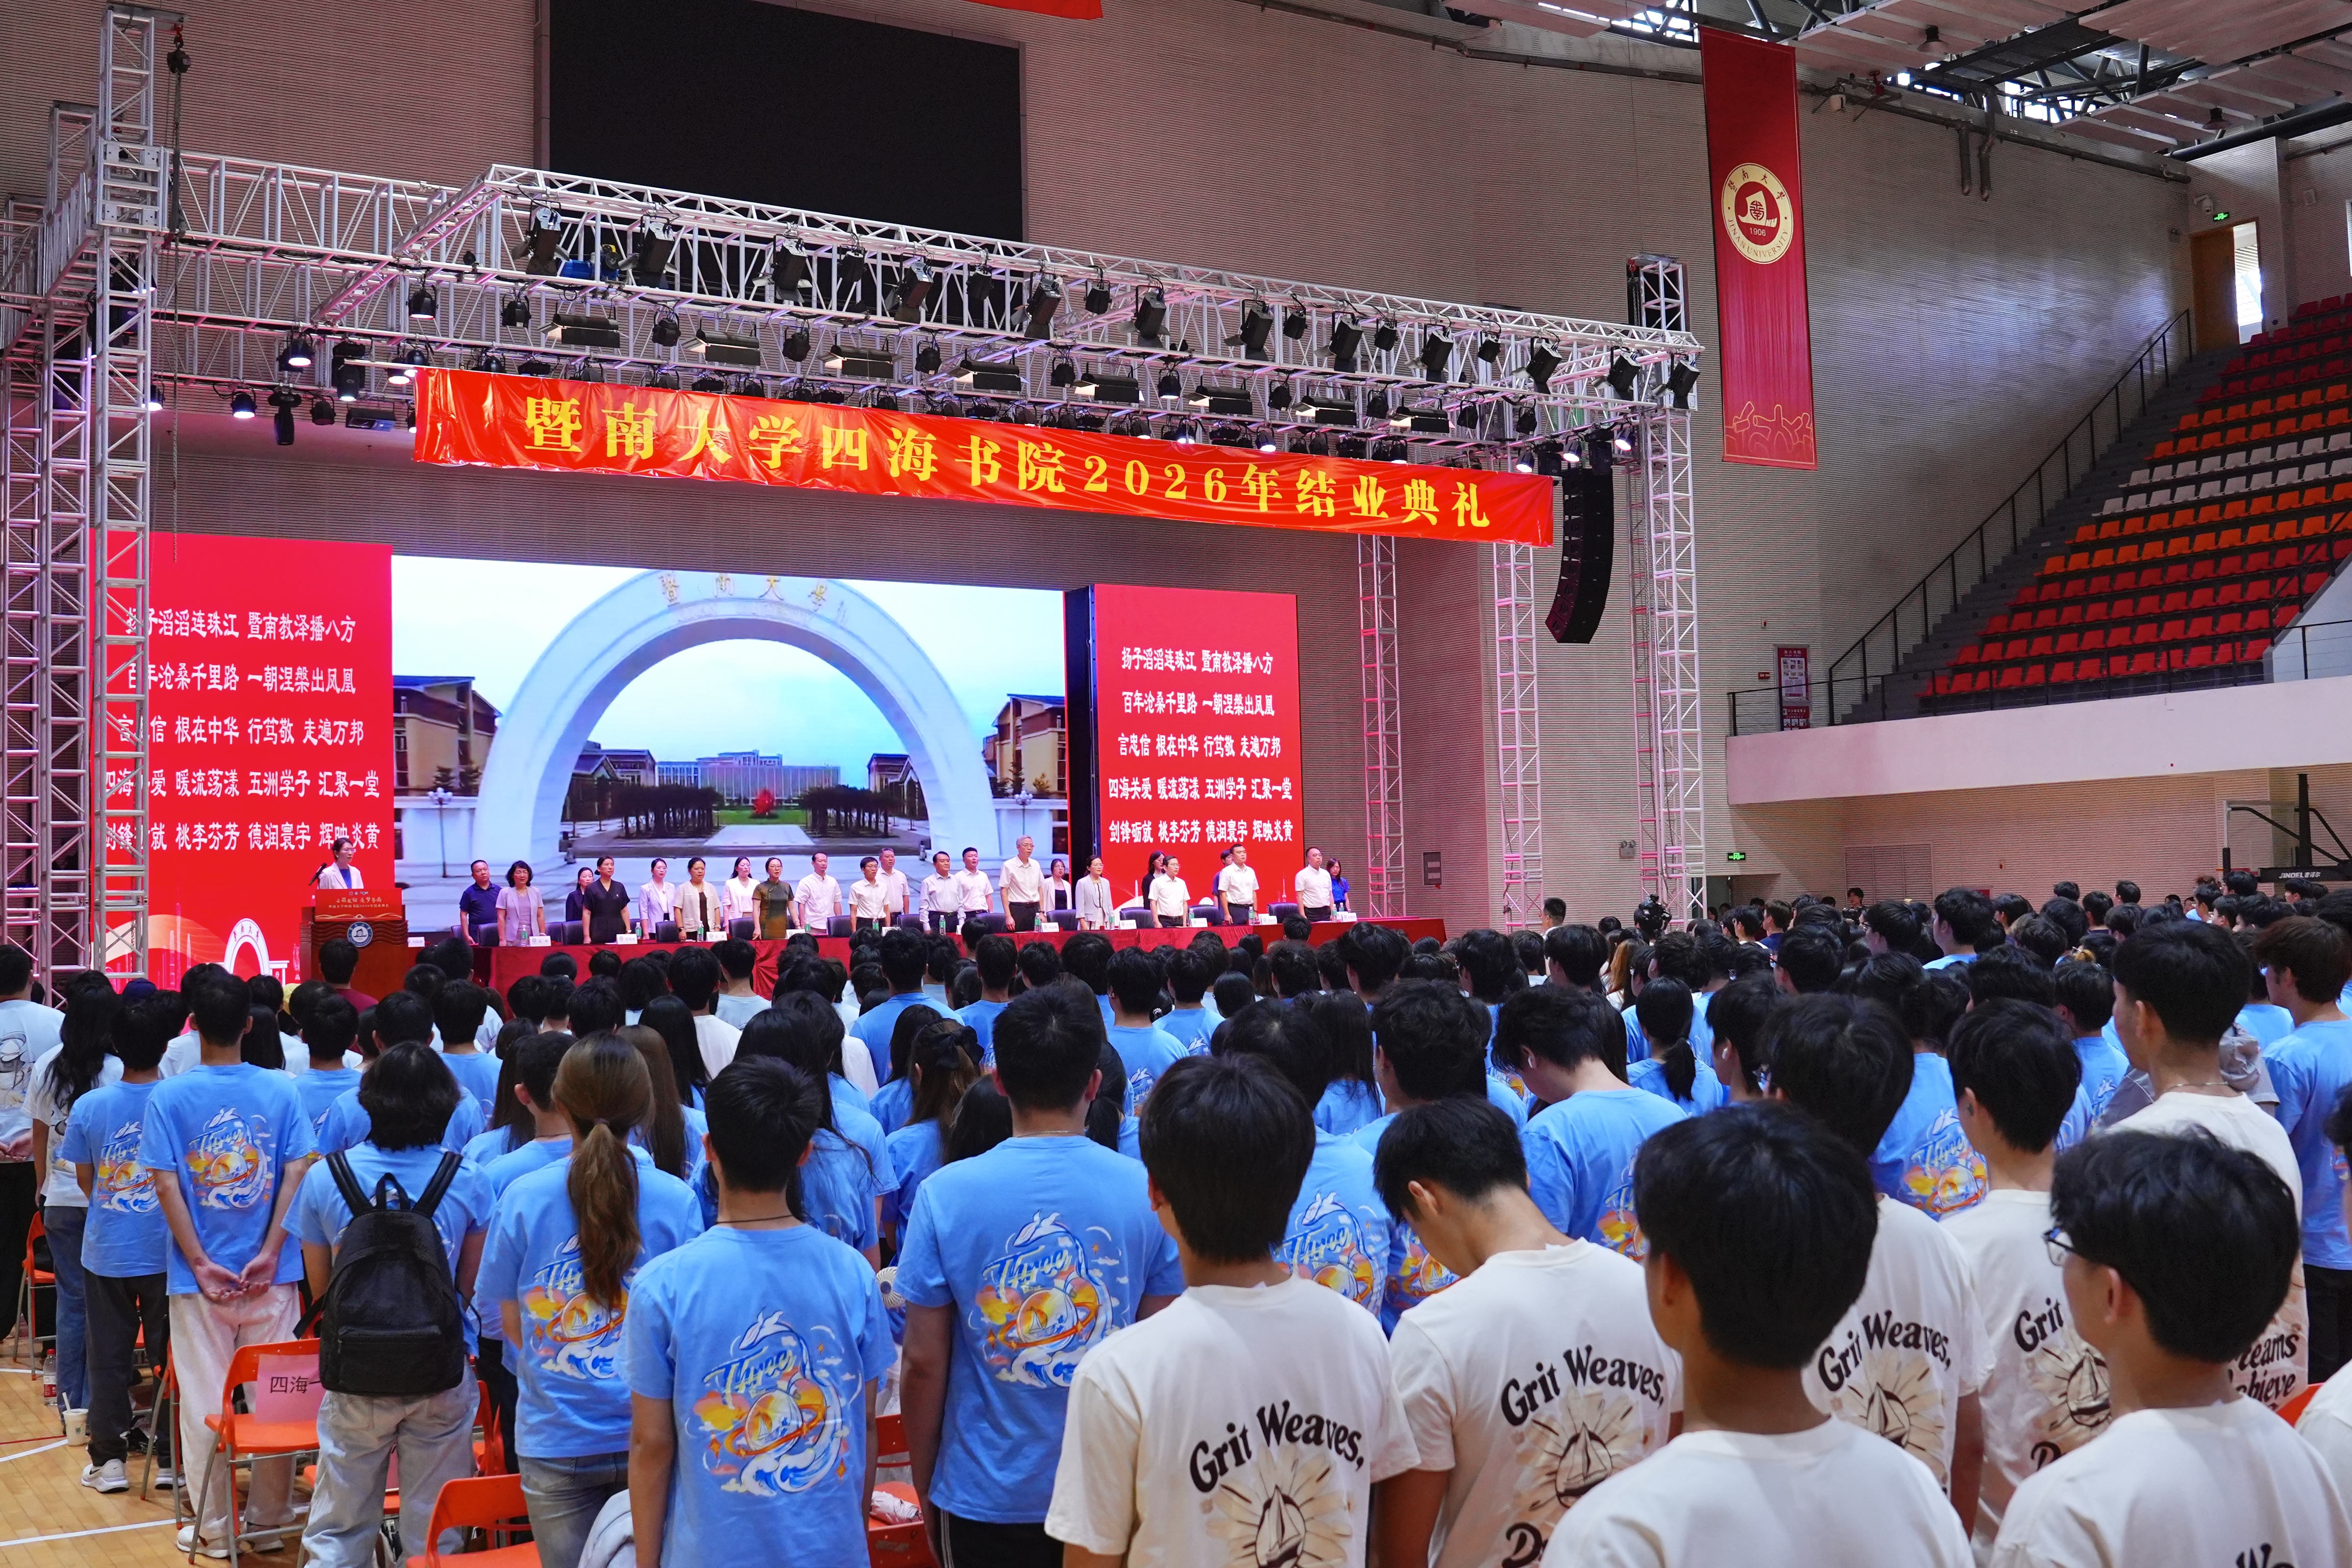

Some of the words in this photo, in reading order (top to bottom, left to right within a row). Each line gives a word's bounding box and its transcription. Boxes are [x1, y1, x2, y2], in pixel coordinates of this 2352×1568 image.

[1747, 229, 1788, 258] UNIVERSITY
[1750, 227, 1766, 236] 1906
[525, 397, 1490, 527] 暨南大学四海书院2026年结业典礼
[248, 612, 356, 643] 暨南教泽播八方
[1121, 647, 1197, 672] 扬子滔滔连珠江
[1201, 649, 1273, 675] 暨南教泽播八方
[248, 665, 356, 694] 一朝涅槃出凤凰
[1122, 690, 1198, 715] 百年沧桑千里路
[1202, 692, 1275, 717] 一朝涅槃出凤凰
[118, 715, 167, 743] 言信
[176, 715, 239, 745] 根在中华
[248, 717, 295, 745] 行笃敬
[303, 718, 364, 746] 走遍万邦
[1118, 732, 1151, 757] 言忠信
[1156, 733, 1199, 757] 根在中华
[1203, 734, 1235, 758] 行笃敬
[1240, 735, 1281, 758] 走遍万邦
[106, 768, 167, 797] 四海爱
[176, 768, 239, 798] 暖流荡漾
[248, 769, 311, 797] 五洲学子
[318, 770, 380, 798] 汇聚一堂
[1108, 776, 1152, 800] 四海关爱
[1157, 776, 1200, 800] 暖流荡漾
[1205, 776, 1246, 800] 五洲学子
[1251, 777, 1292, 800] 汇聚一堂
[176, 821, 240, 851] 桃李芬芳
[248, 821, 311, 850] 德润寰宇
[318, 822, 380, 850] 辉映炎黄
[1109, 819, 1154, 844] 剑锋砺就
[1158, 819, 1201, 844] 桃李芬芳
[1206, 819, 1248, 844] 德润寰宇
[1252, 819, 1293, 843] 辉映炎黄
[534, 1257, 584, 1303] Thr
[982, 1244, 1072, 1304] Three
[2014, 1297, 2065, 1352] Grit
[1817, 1330, 1863, 1392] Grit
[1862, 1309, 1951, 1371] Weaves,
[702, 1345, 796, 1410] Three
[1501, 1362, 1561, 1426] Grit
[1563, 1344, 1664, 1410] Weaves,
[1190, 1422, 1252, 1493] Grit
[1257, 1400, 1365, 1473] Weaves,
